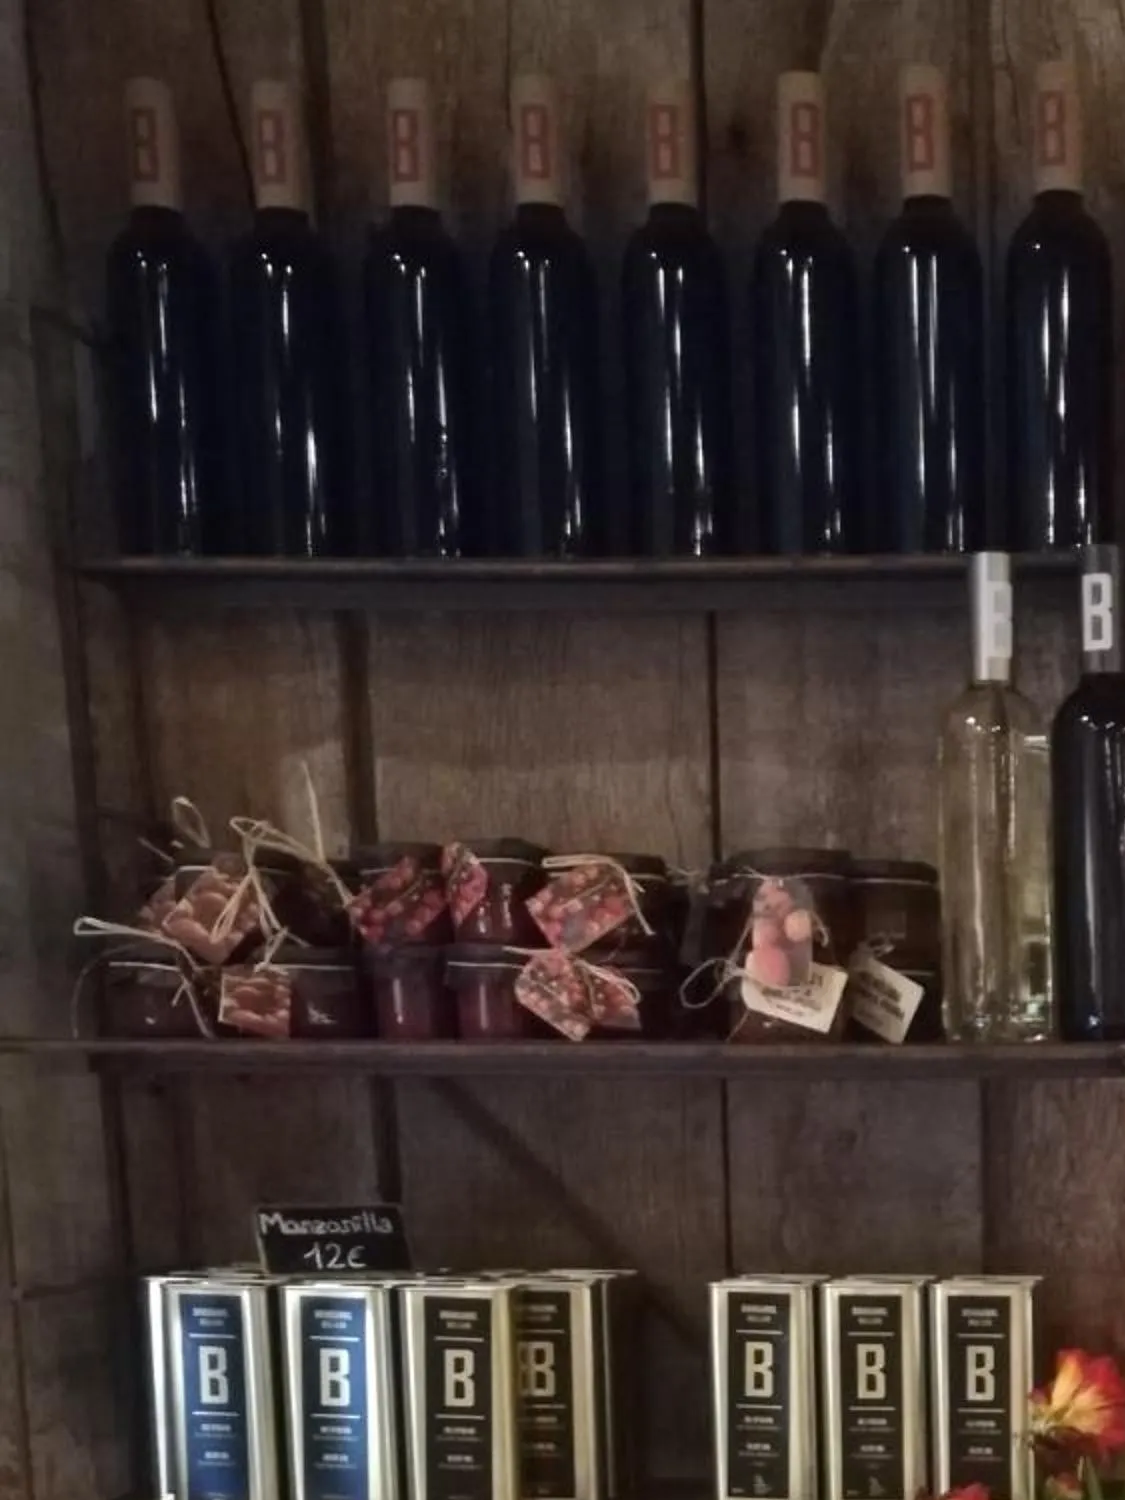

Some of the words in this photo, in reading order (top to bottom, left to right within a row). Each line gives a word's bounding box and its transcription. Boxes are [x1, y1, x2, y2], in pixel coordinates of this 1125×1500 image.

[1082, 573, 1112, 650] B
[304, 1241, 367, 1270] 12€
[198, 1346, 229, 1405] B
[320, 1348, 351, 1407] B
[444, 1349, 475, 1407] B
[745, 1342, 773, 1397] B
[857, 1344, 886, 1399] B
[966, 1345, 995, 1400] B
